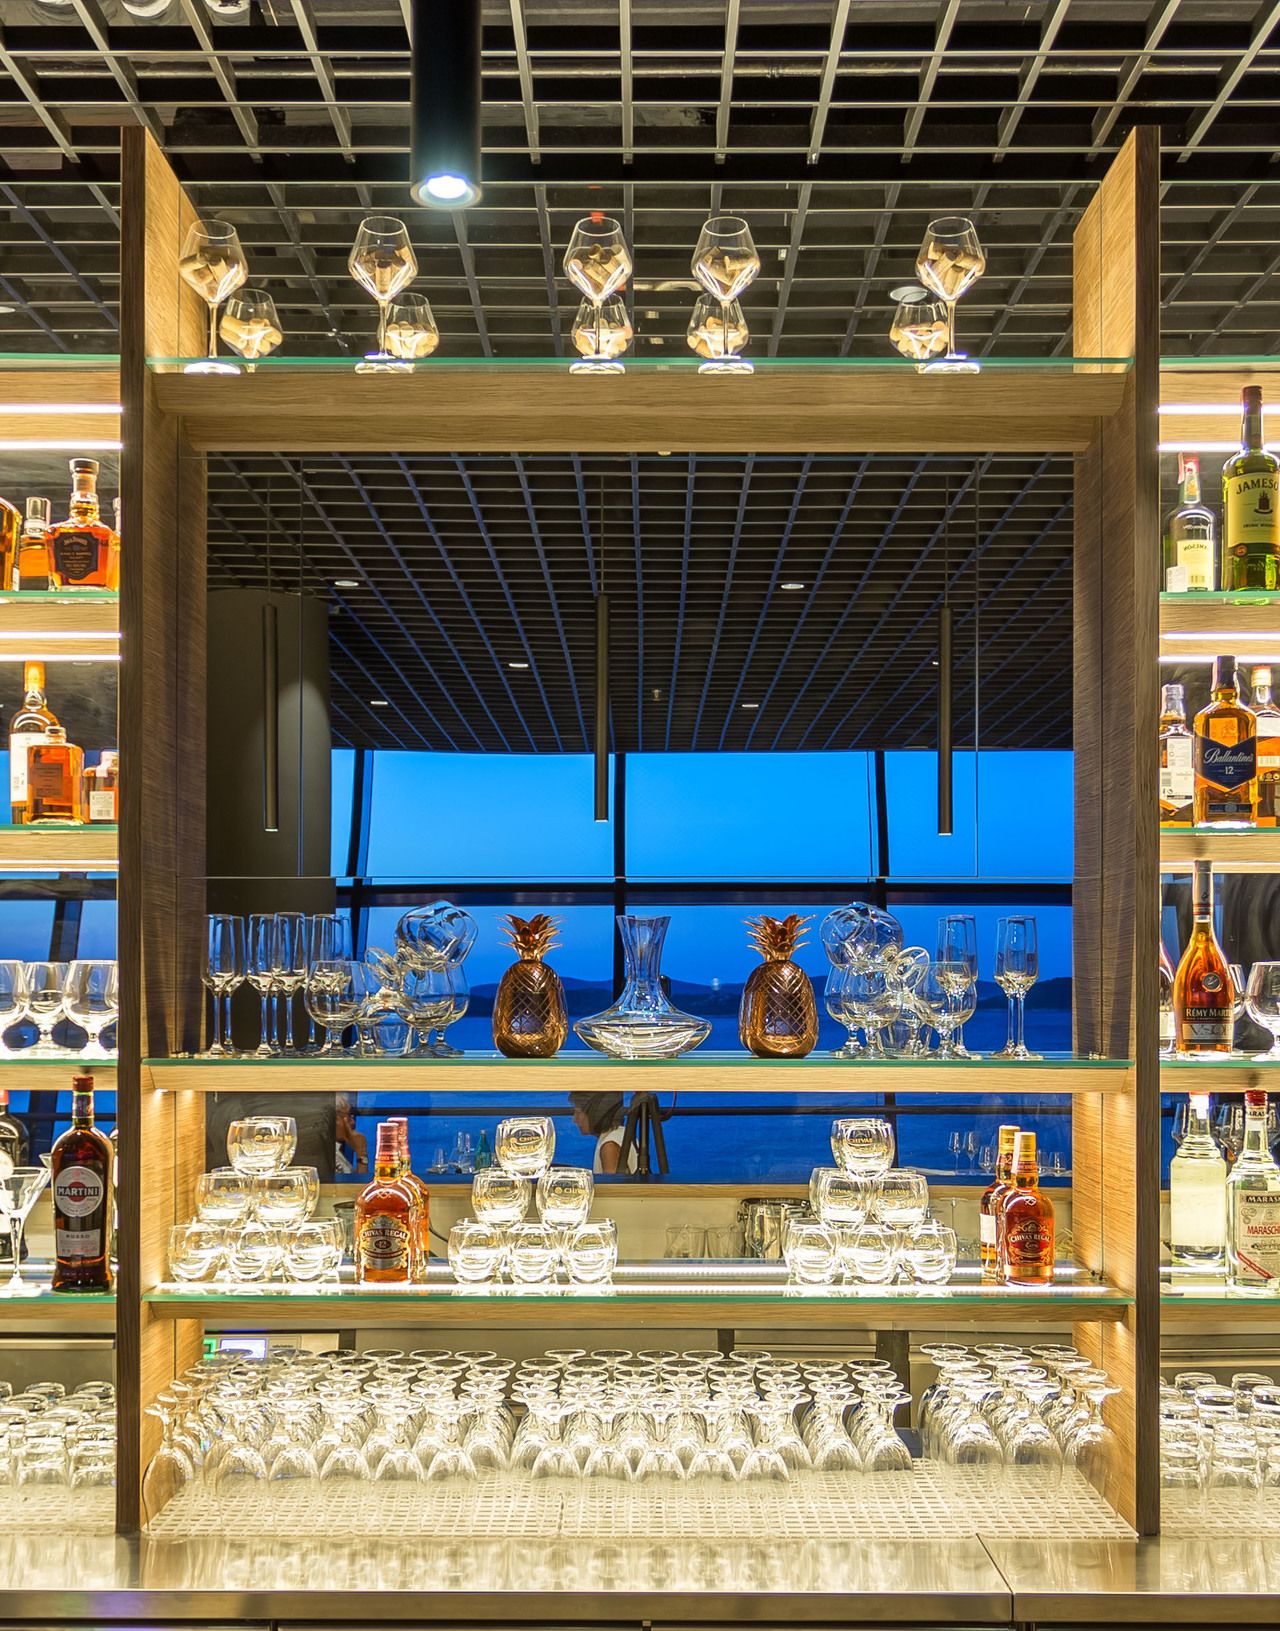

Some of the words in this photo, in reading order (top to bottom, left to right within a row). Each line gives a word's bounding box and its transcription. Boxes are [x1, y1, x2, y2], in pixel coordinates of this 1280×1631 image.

[1203, 747, 1254, 764] Ballantine's
[1224, 766, 1234, 775] 12
[1185, 1006, 1208, 1018] RÉMY
[57, 1186, 99, 1197] MARTINI
[362, 1229, 384, 1238] CHIVAS
[384, 1228, 408, 1239] REGAL
[1010, 1234, 1033, 1243] CHIVAS
